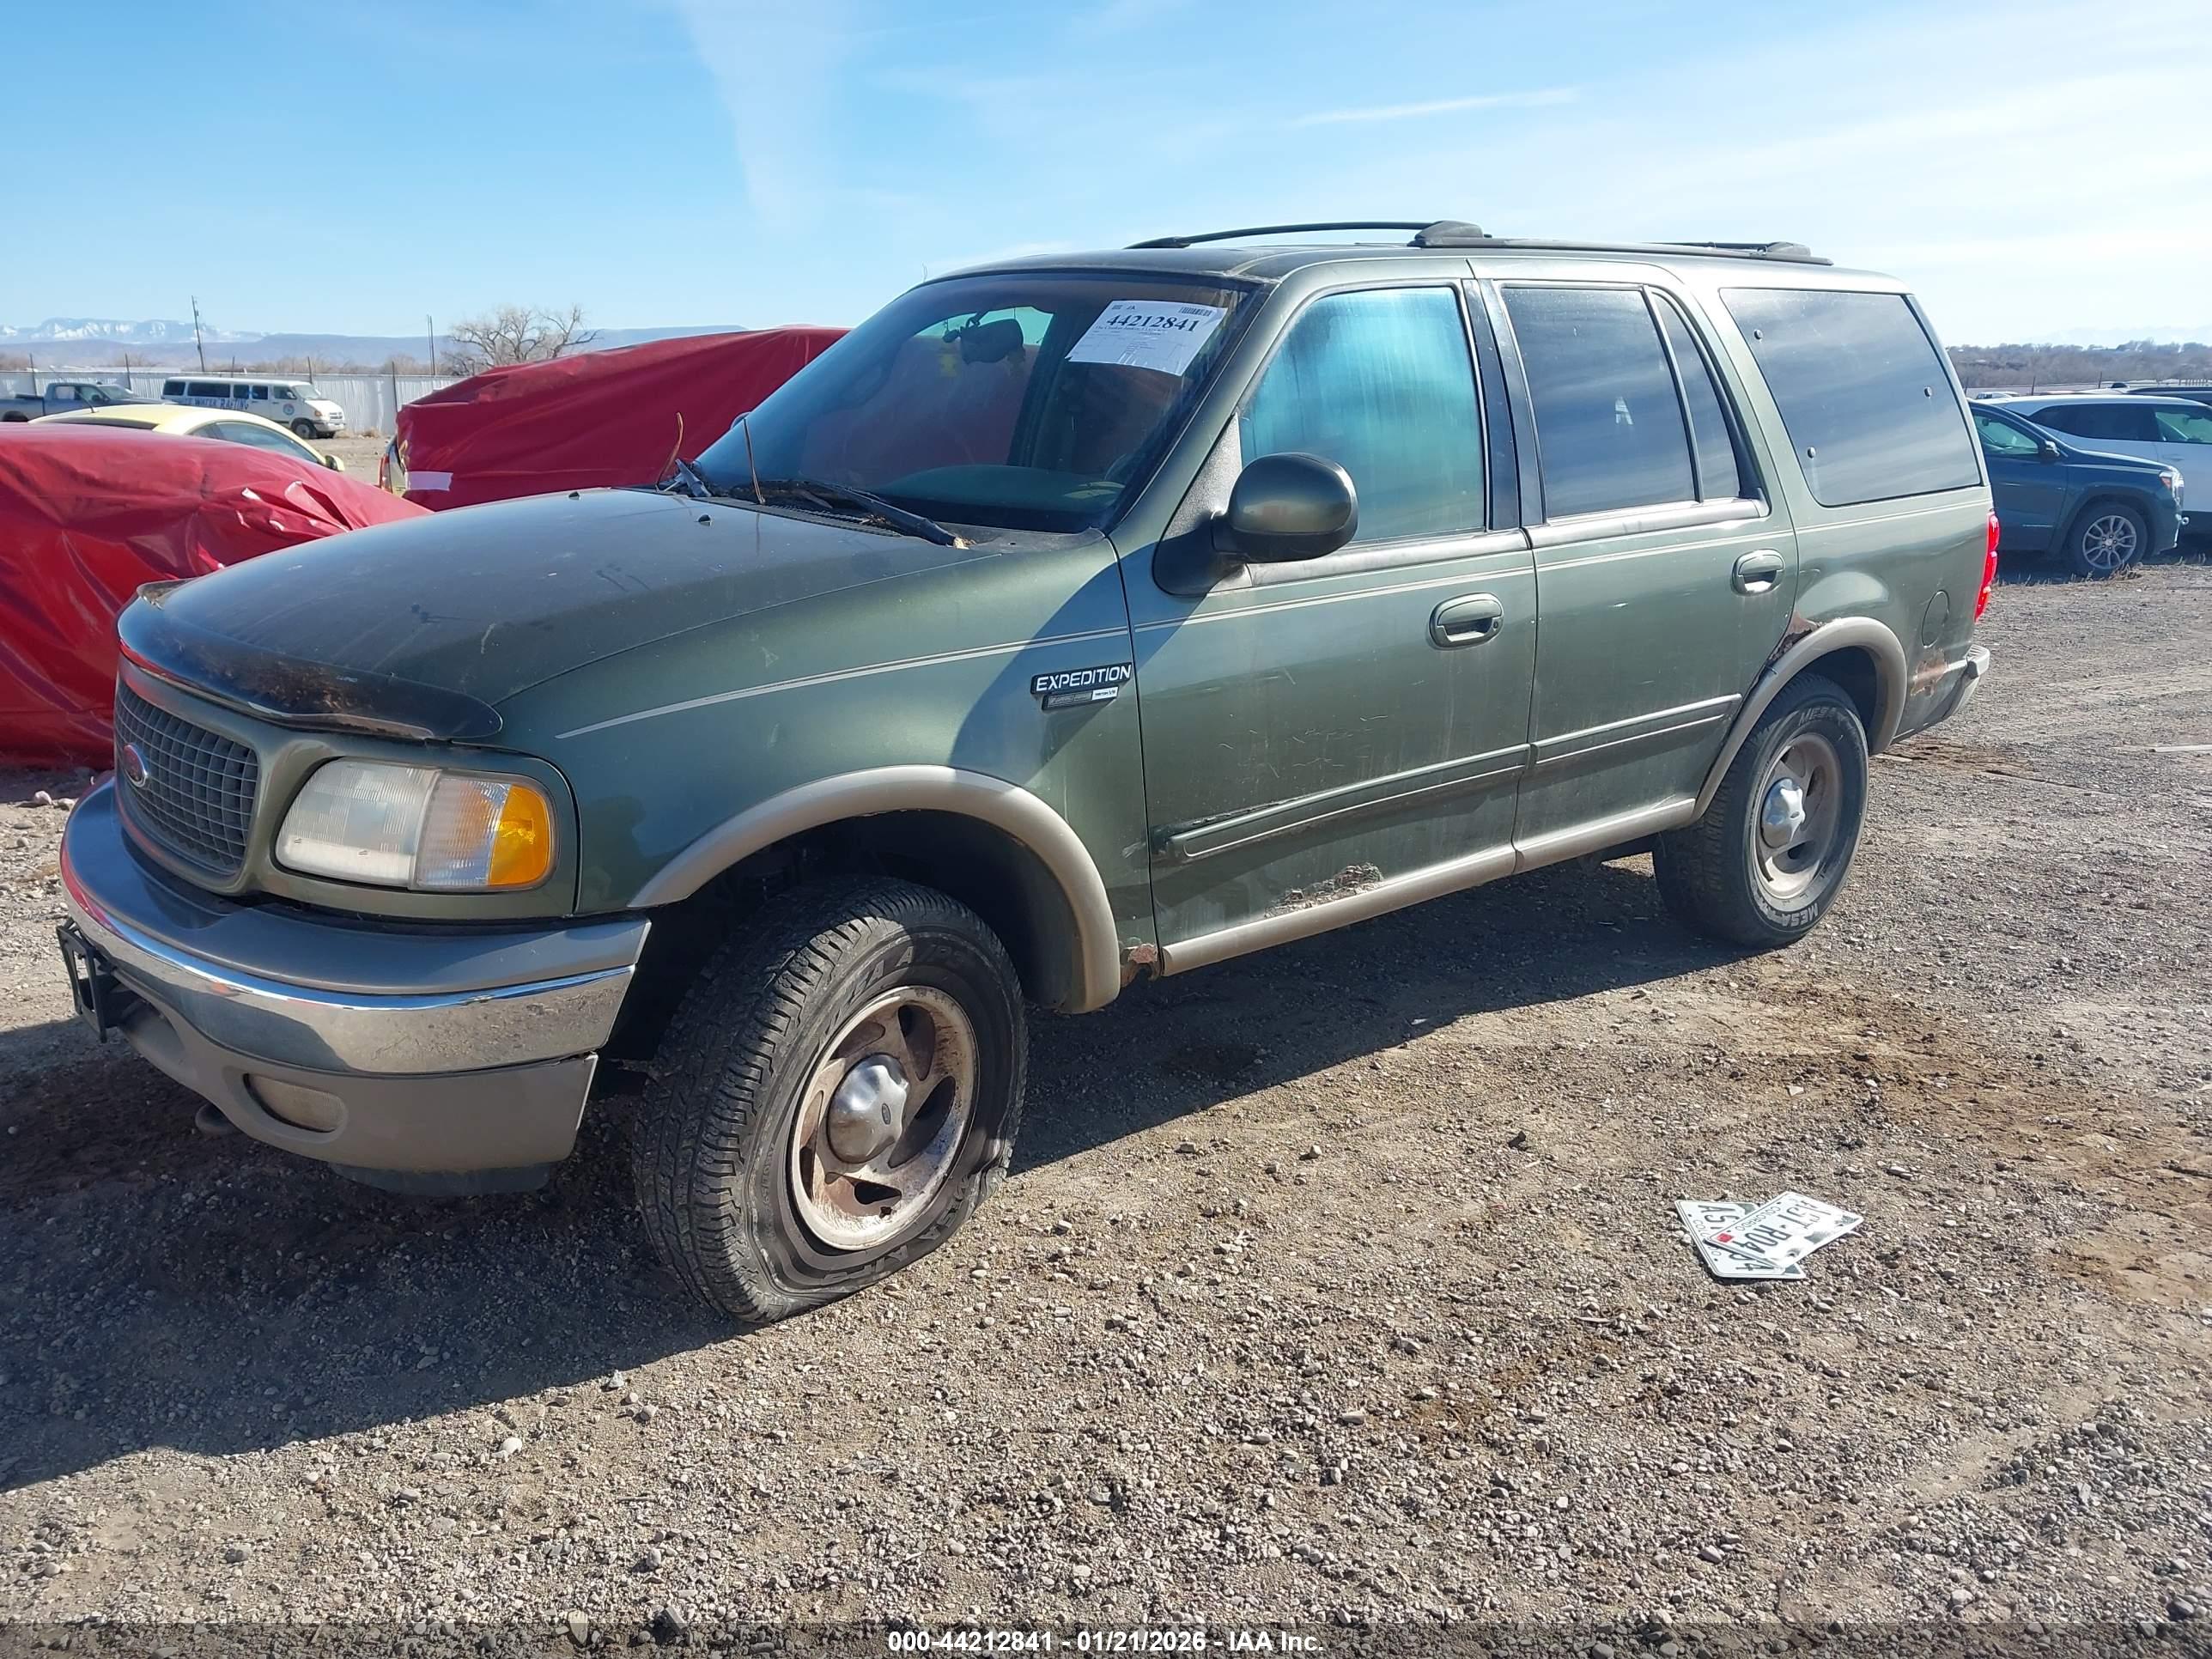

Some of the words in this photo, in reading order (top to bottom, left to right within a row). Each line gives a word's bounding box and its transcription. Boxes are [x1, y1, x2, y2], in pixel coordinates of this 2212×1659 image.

[1106, 314, 1200, 331] 44212841
[1036, 665, 1132, 692] EXPEDITION
[1733, 1205, 1782, 1232] COLORADO
